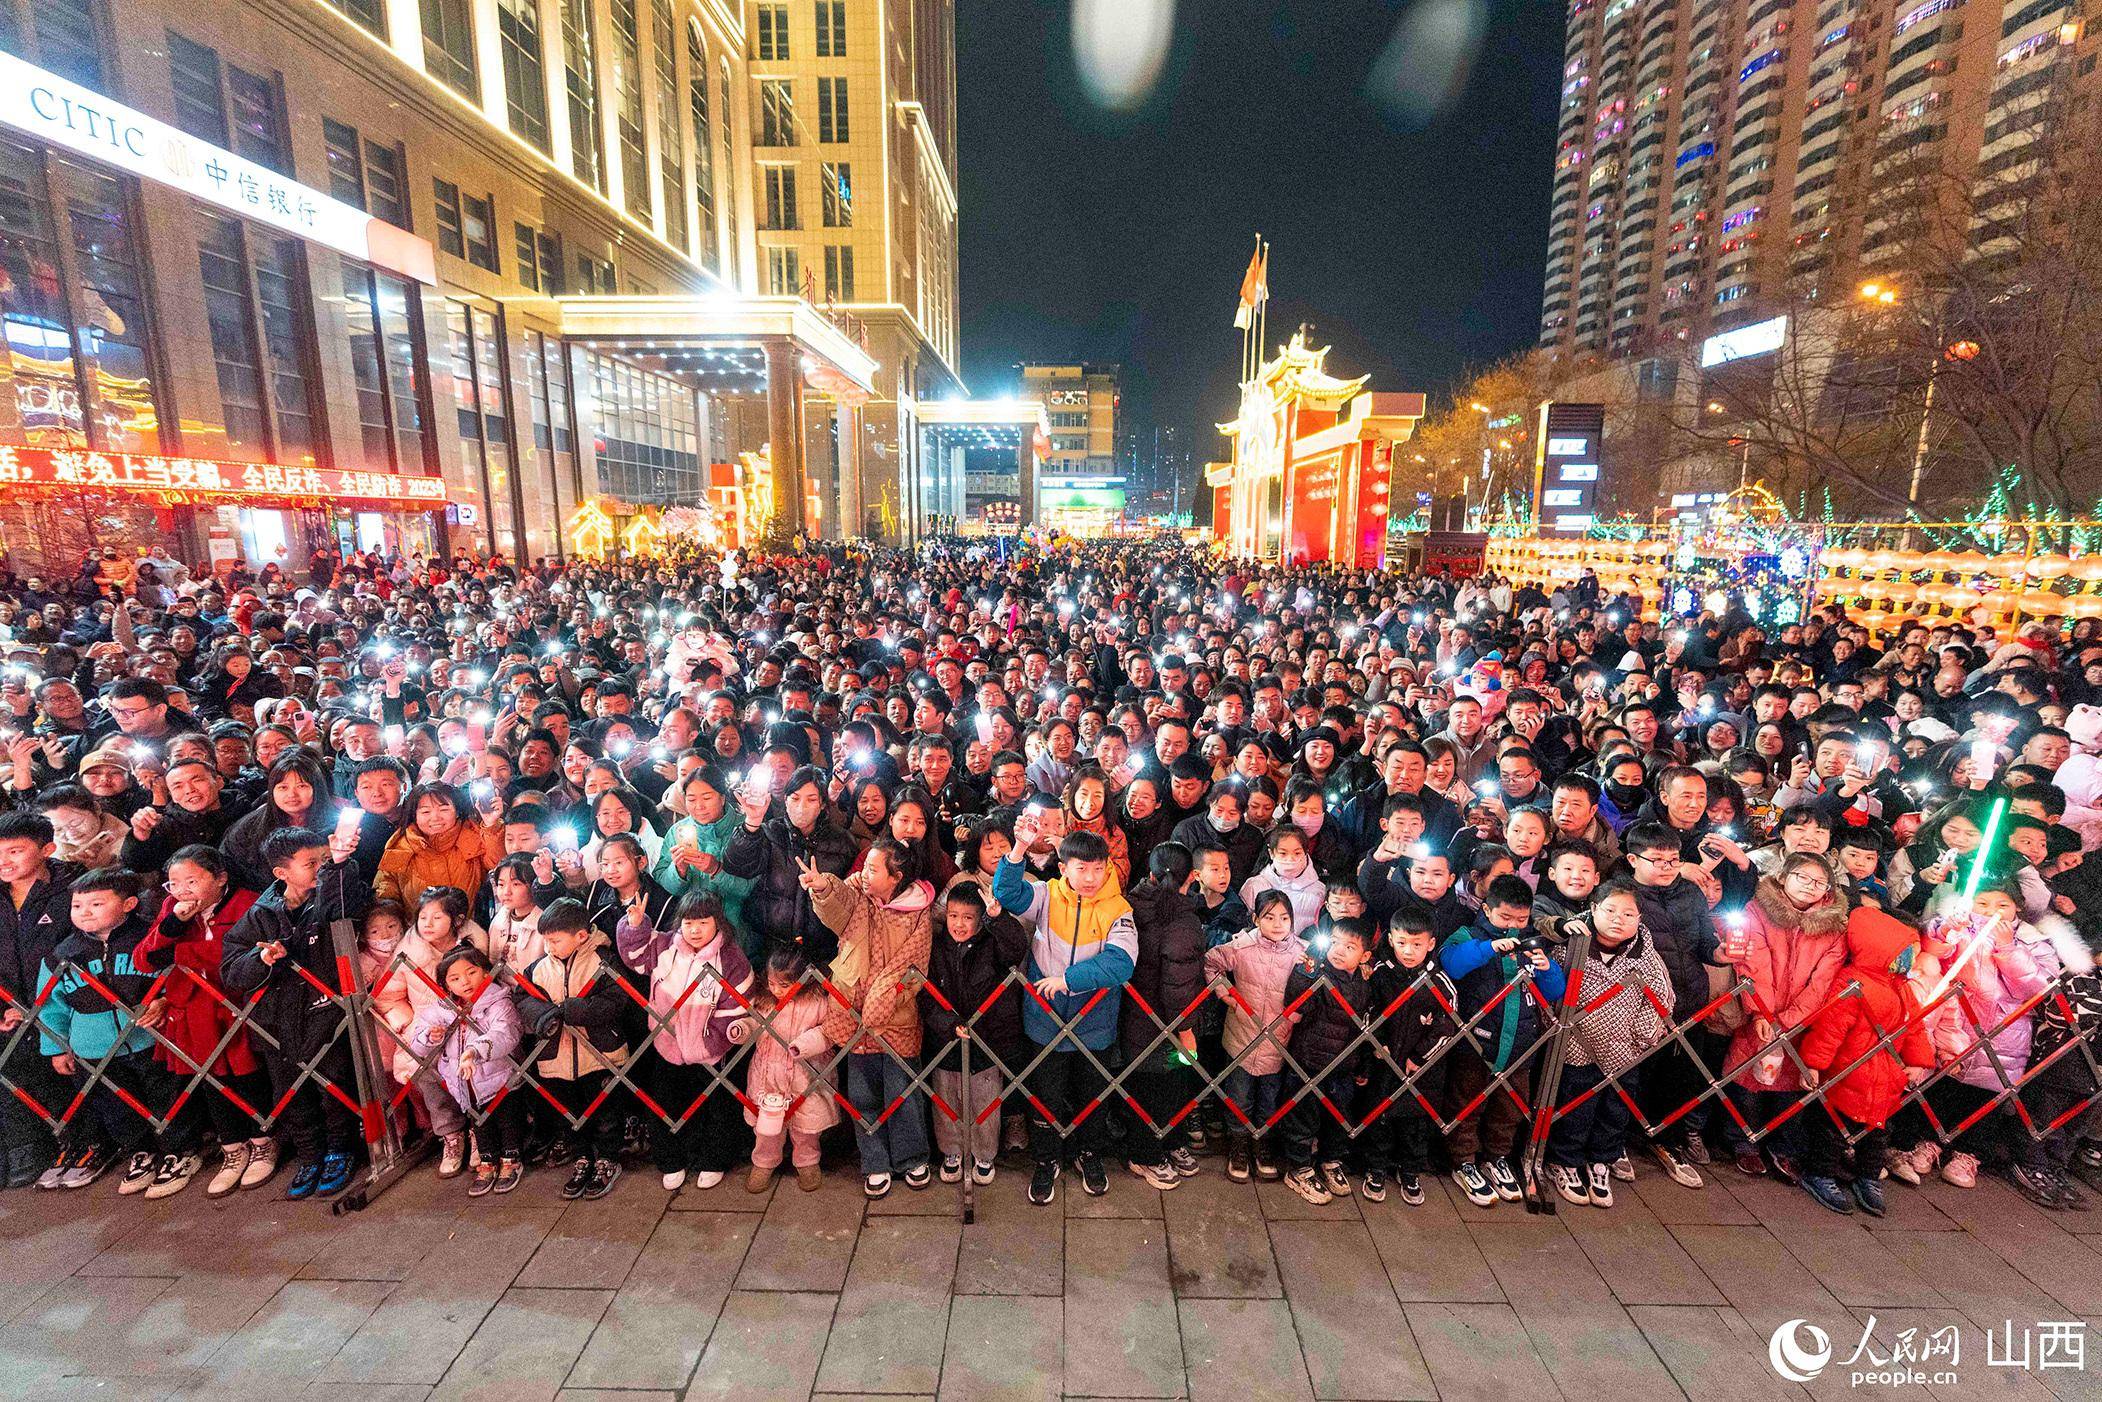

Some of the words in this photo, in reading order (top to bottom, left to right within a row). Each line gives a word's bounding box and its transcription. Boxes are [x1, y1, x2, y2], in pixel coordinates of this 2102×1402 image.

[29, 86, 146, 157] CITIC
[204, 158, 317, 226] 中信银行
